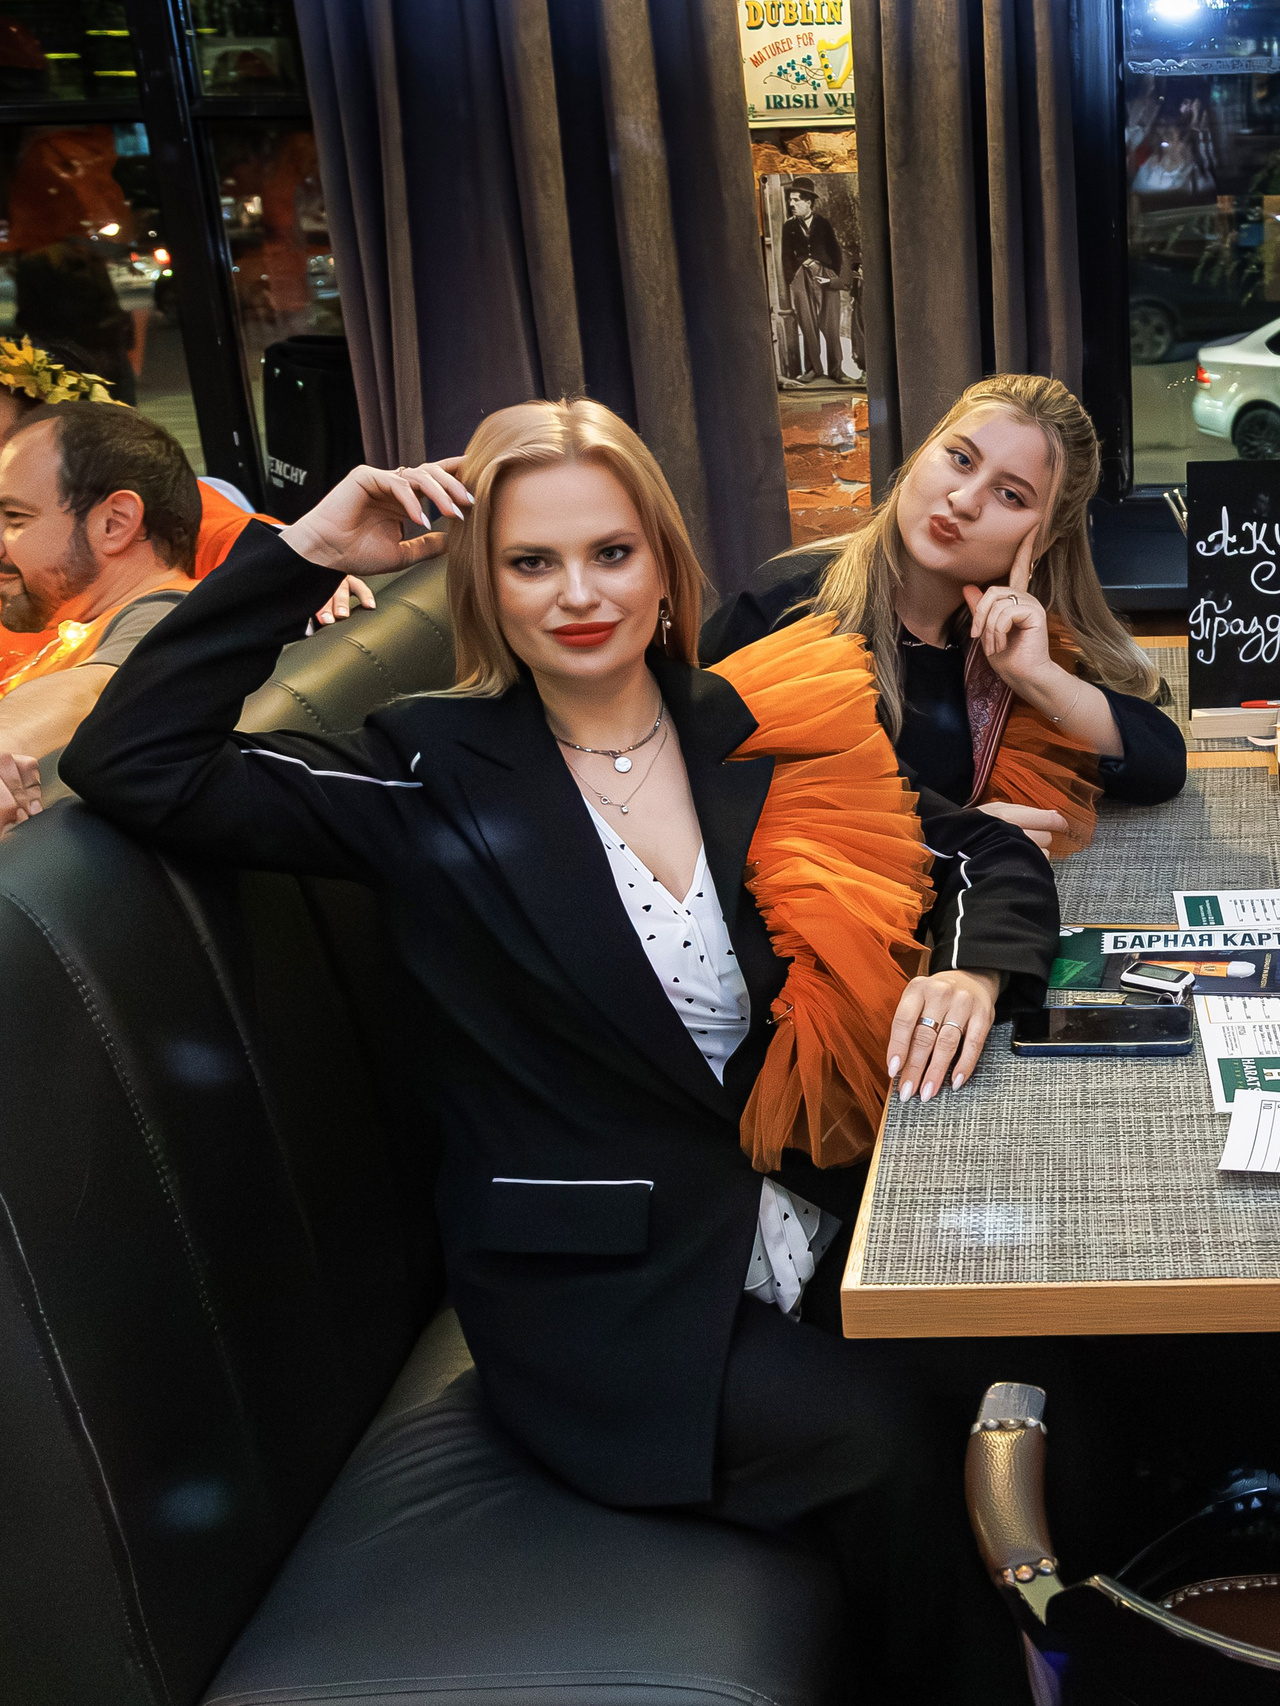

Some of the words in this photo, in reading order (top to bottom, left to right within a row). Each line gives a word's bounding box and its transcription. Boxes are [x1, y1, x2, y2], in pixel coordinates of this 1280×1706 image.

[746, 0, 843, 30] DUBLIN
[749, 37, 794, 68] MATURED
[796, 32, 815, 47] FOR
[765, 94, 818, 110] IRISH
[1112, 933, 1213, 950] БАРНАЯ
